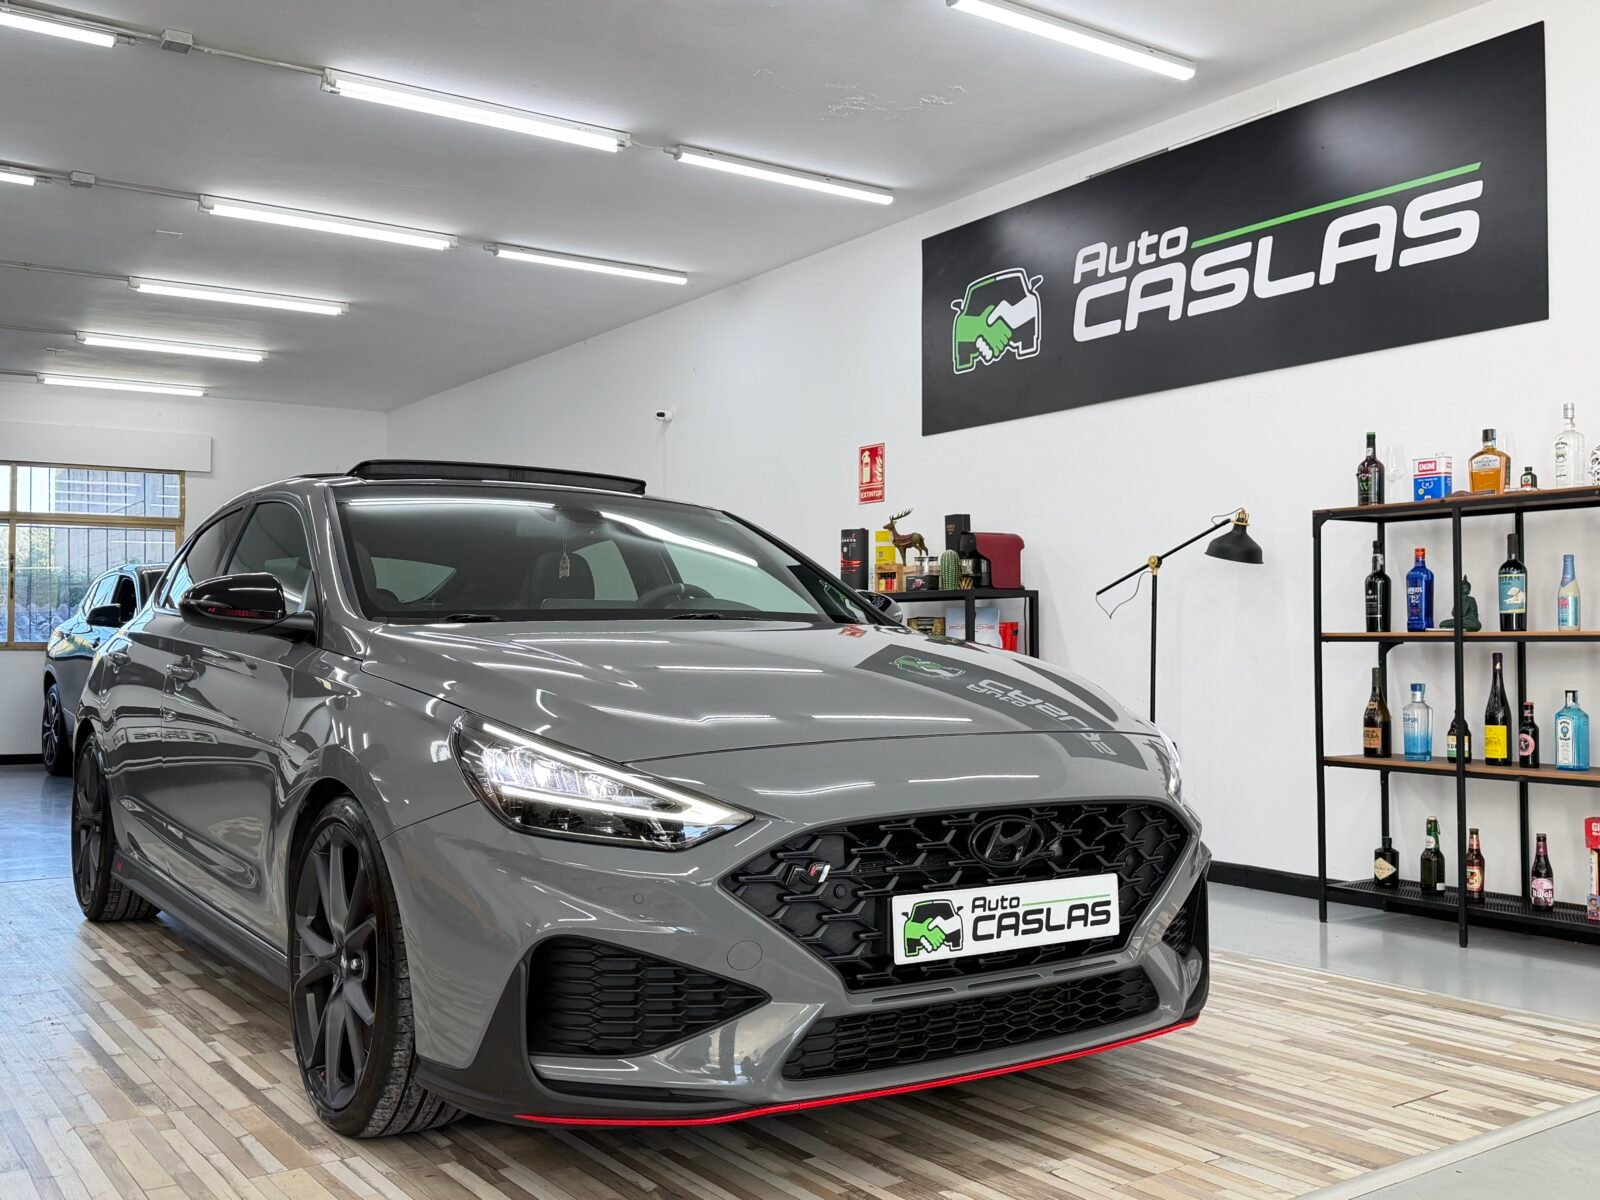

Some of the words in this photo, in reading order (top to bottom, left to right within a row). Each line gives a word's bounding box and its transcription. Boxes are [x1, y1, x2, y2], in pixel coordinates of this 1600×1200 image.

[1073, 226, 1189, 285] Auto
[1073, 180, 1483, 342] CASLAS
[860, 489, 883, 499] EXTINTOR
[971, 895, 1020, 914] Auto
[972, 900, 1112, 942] CASLAS
